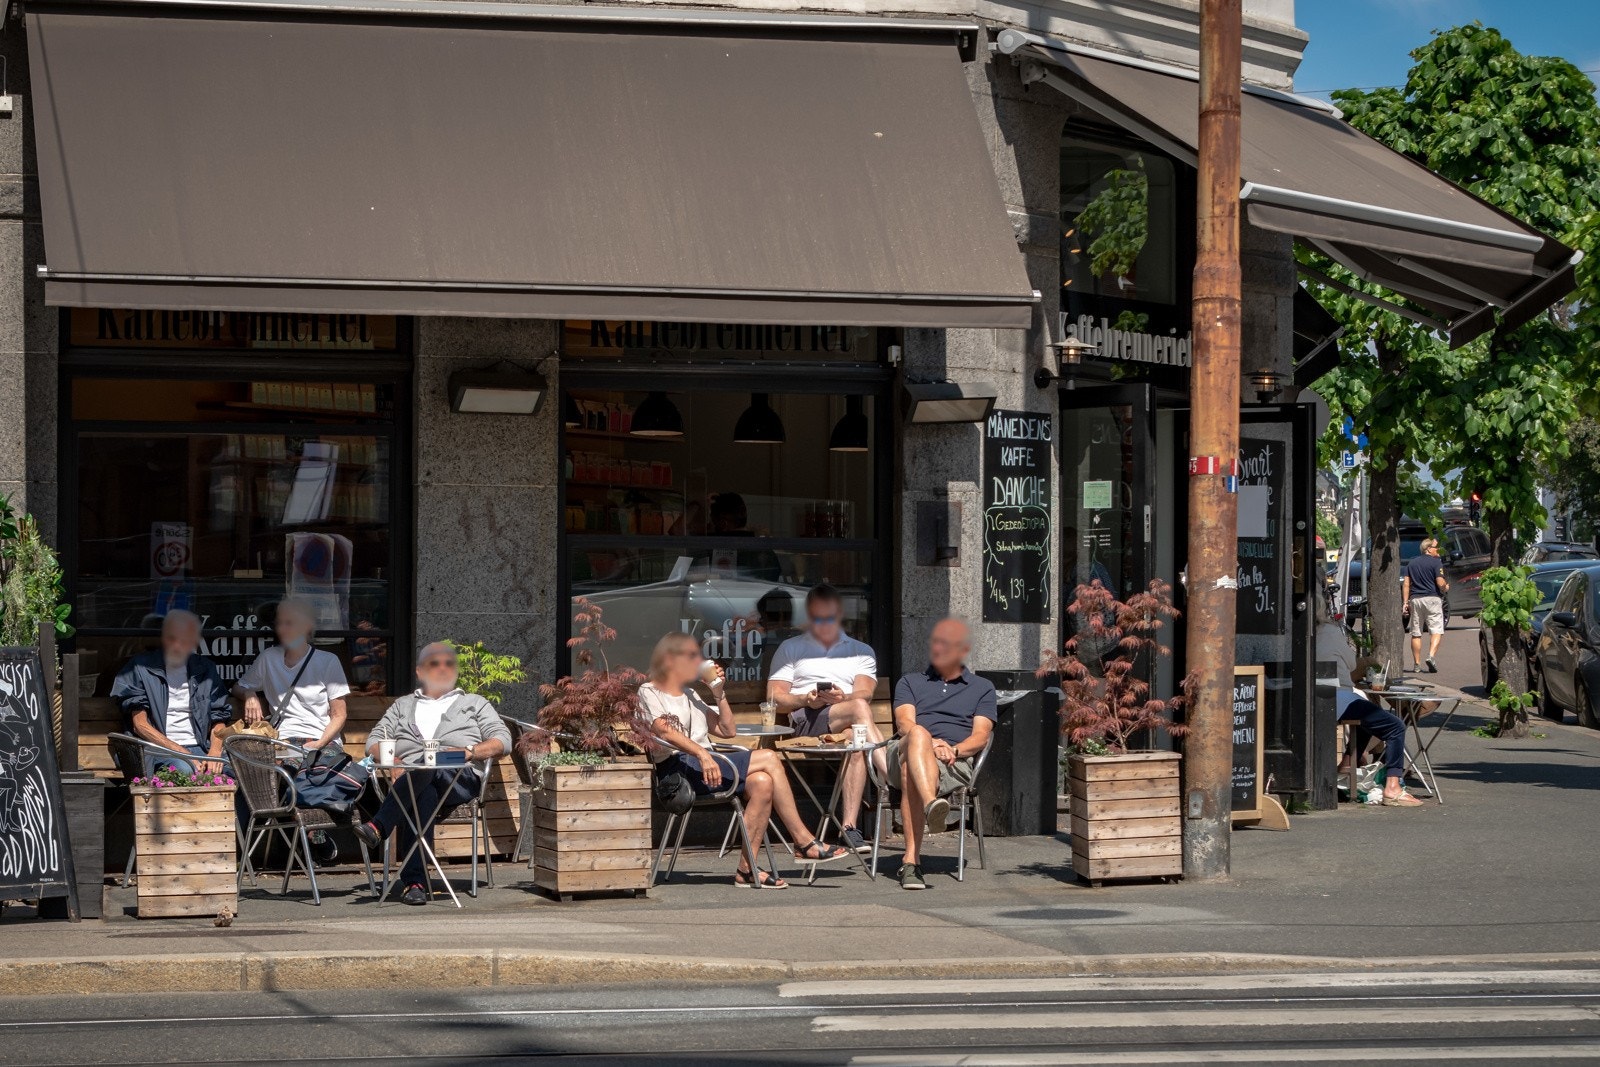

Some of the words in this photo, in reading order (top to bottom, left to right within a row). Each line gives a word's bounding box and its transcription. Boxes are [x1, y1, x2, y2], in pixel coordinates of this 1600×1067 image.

[987, 411, 1051, 440] MÅNEDENS
[1001, 447, 1035, 467] KAFFE
[1238, 444, 1274, 482] Svart
[992, 476, 1048, 507] DANCHE
[726, 662, 762, 681] eriet
